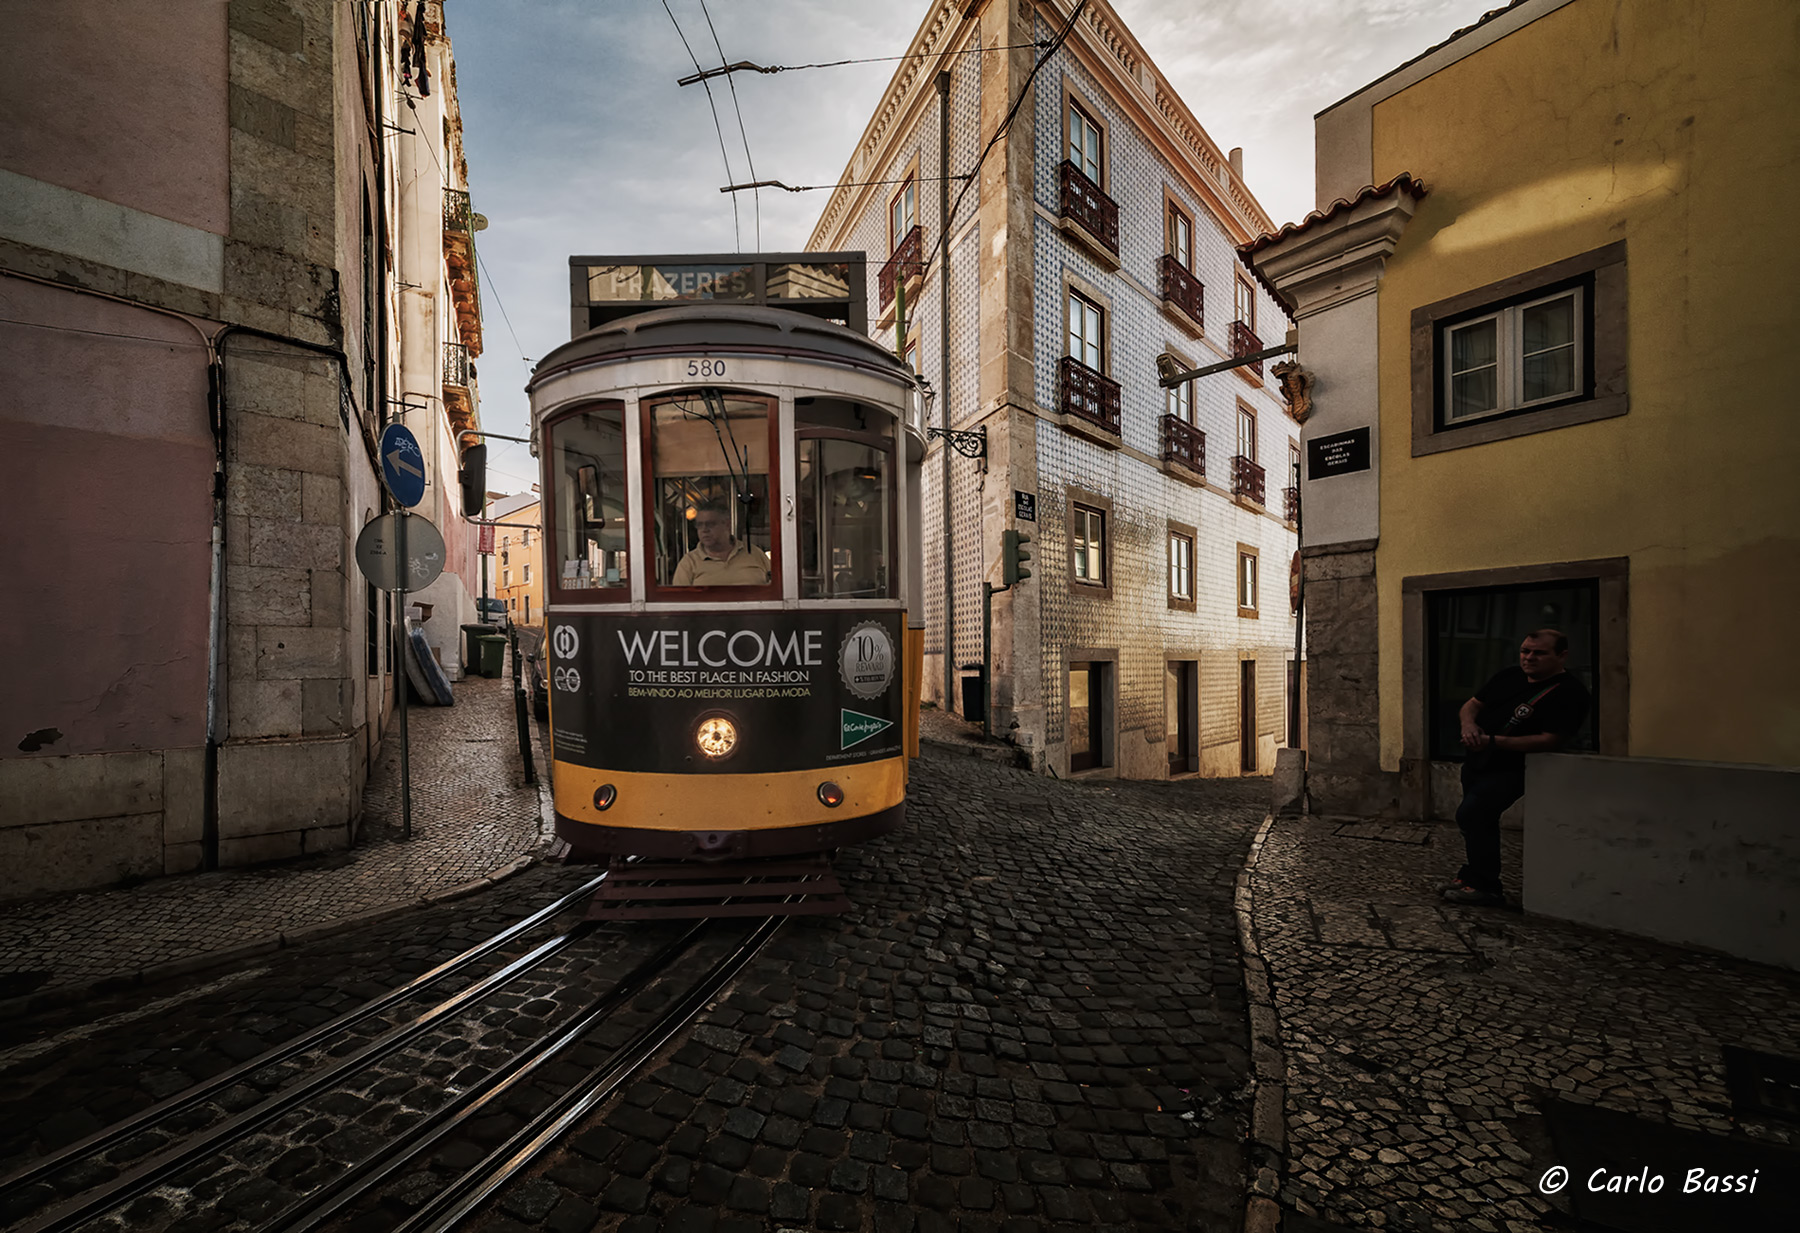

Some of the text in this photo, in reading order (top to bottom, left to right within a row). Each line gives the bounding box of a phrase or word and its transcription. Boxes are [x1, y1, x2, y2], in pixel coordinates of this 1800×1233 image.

[688, 359, 726, 377] 580
[617, 630, 823, 667] WELCOME
[856, 662, 884, 672] REWARD
[629, 670, 809, 683] TO THE BEST PLACE IN FASHION
[628, 687, 811, 698] BEM-VINDO AO MELHOR LUGAR DA MODA
